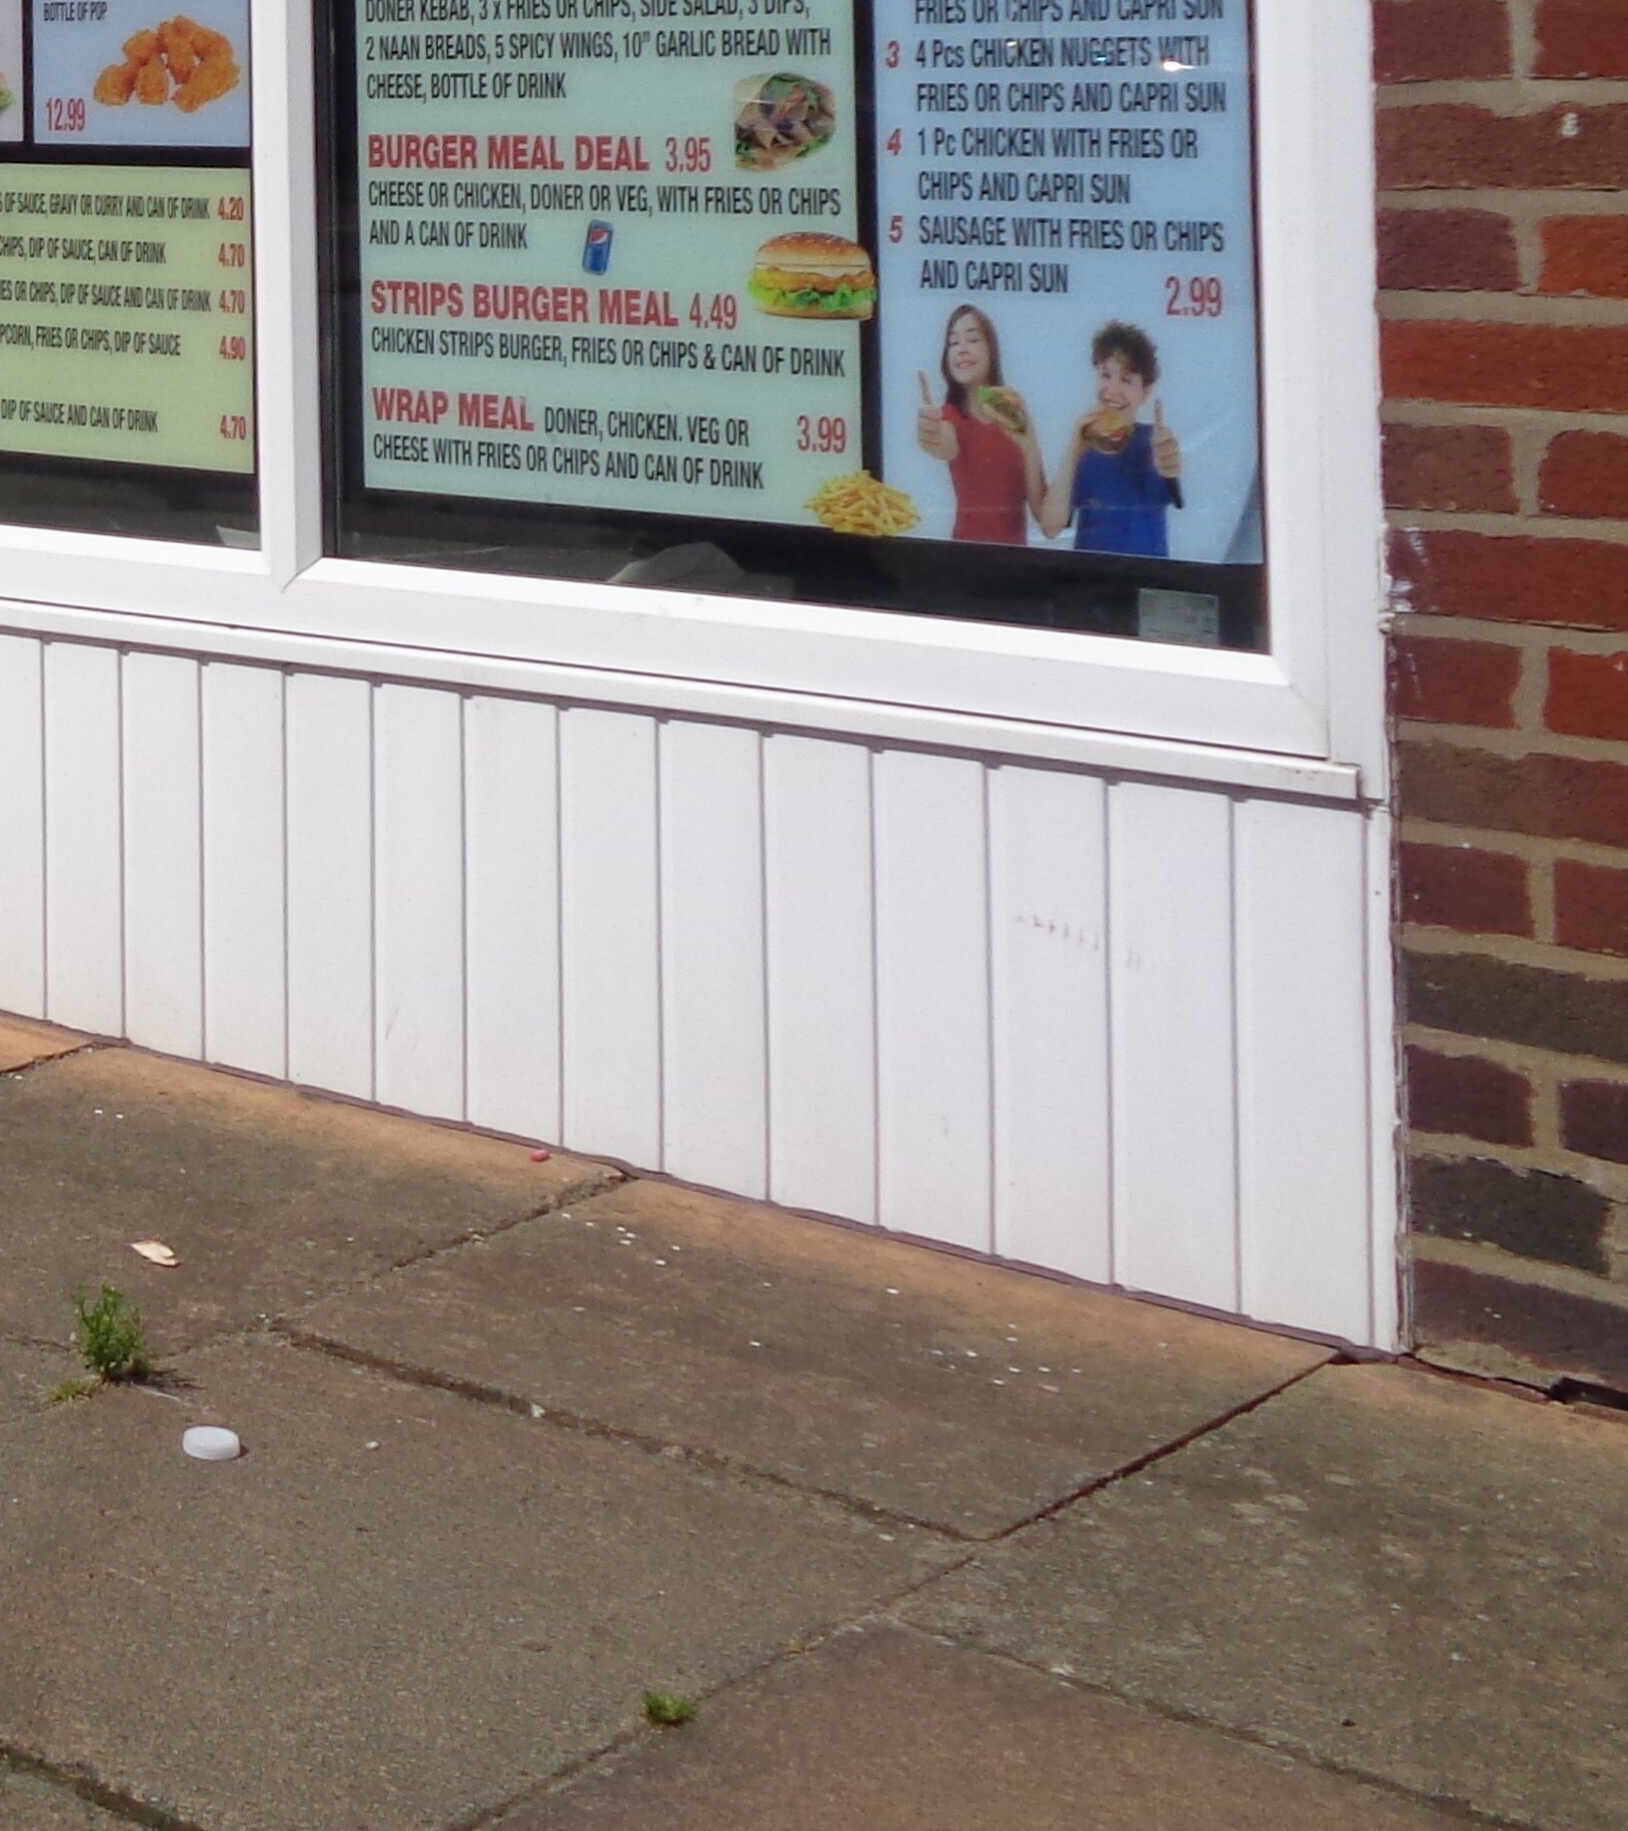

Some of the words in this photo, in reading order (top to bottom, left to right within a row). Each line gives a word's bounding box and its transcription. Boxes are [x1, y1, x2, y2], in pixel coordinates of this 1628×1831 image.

[45, 97, 86, 133] 12.99
[367, 134, 477, 170] BURGER
[488, 135, 563, 171] MEAL
[575, 136, 649, 172] DEAL
[665, 137, 711, 172] 3.95
[917, 171, 973, 202] CHIPS
[979, 172, 1019, 203] AND
[1026, 171, 1084, 203] CAPRI
[1090, 172, 1131, 205] SUN
[217, 193, 245, 222] 4.20
[371, 280, 464, 318] STRIPS
[473, 284, 589, 323] BURGER
[599, 289, 678, 327] MEAL
[689, 293, 738, 330] 4.49
[1165, 274, 1223, 317] 2.99
[372, 387, 449, 425] WRAP
[458, 392, 534, 432] MEAL
[544, 406, 603, 442] DONER,
[687, 416, 720, 445] VEG
[725, 419, 749, 447] OR
[796, 415, 847, 453] 3.99
